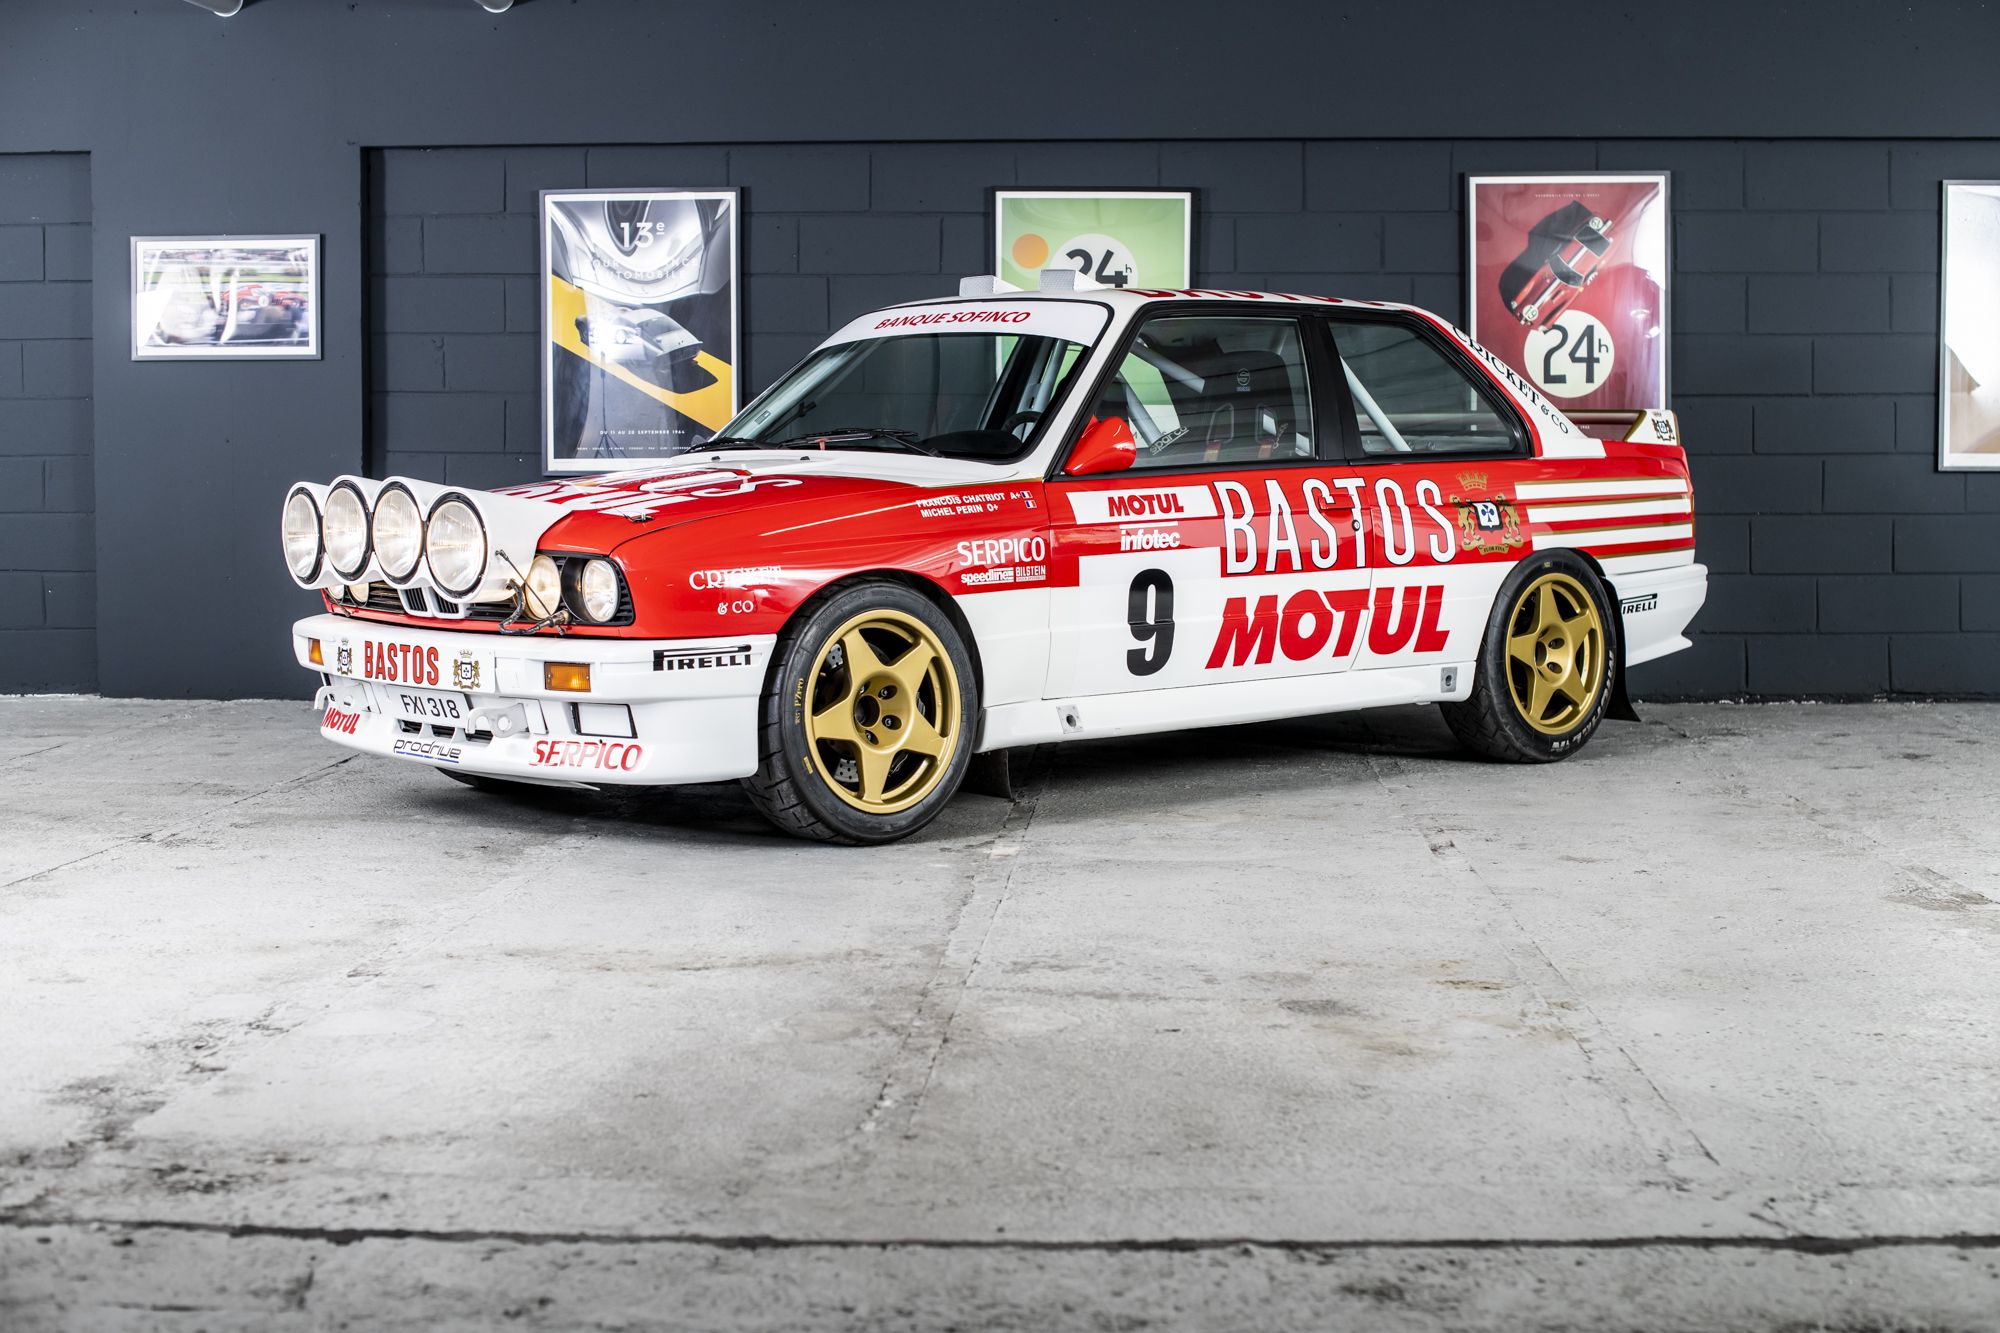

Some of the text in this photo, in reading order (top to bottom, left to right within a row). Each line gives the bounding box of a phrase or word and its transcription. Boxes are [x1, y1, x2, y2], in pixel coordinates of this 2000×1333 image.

[874, 312, 1031, 330] BANQUE SOFINCO
[1543, 324, 1609, 384] 24h
[1541, 404, 1550, 416] &
[1551, 414, 1568, 433] CO
[1150, 426, 1189, 454] sparco
[916, 491, 1021, 508] FRANCOIS CHATRIOT A+
[920, 507, 956, 518] MICHEL
[956, 504, 983, 515] PERIN
[1107, 493, 1184, 517] MOTUL
[1212, 476, 1456, 575] BASTOS
[957, 537, 1046, 567] SERPICO
[1120, 529, 1180, 551] infotec
[689, 565, 781, 590] CRIT
[961, 568, 1012, 584] speedline
[1015, 565, 1046, 577] BILSTEIN
[717, 600, 754, 615] & CO
[1126, 568, 1174, 677] 9
[1205, 585, 1450, 669] MOTUL
[364, 640, 440, 686] BASTOS
[653, 644, 752, 672] PIRELLI
[400, 694, 461, 719] FXI 318
[321, 707, 361, 735] MOTUL
[393, 738, 462, 759] prodrive
[528, 739, 643, 772] SERPICO
